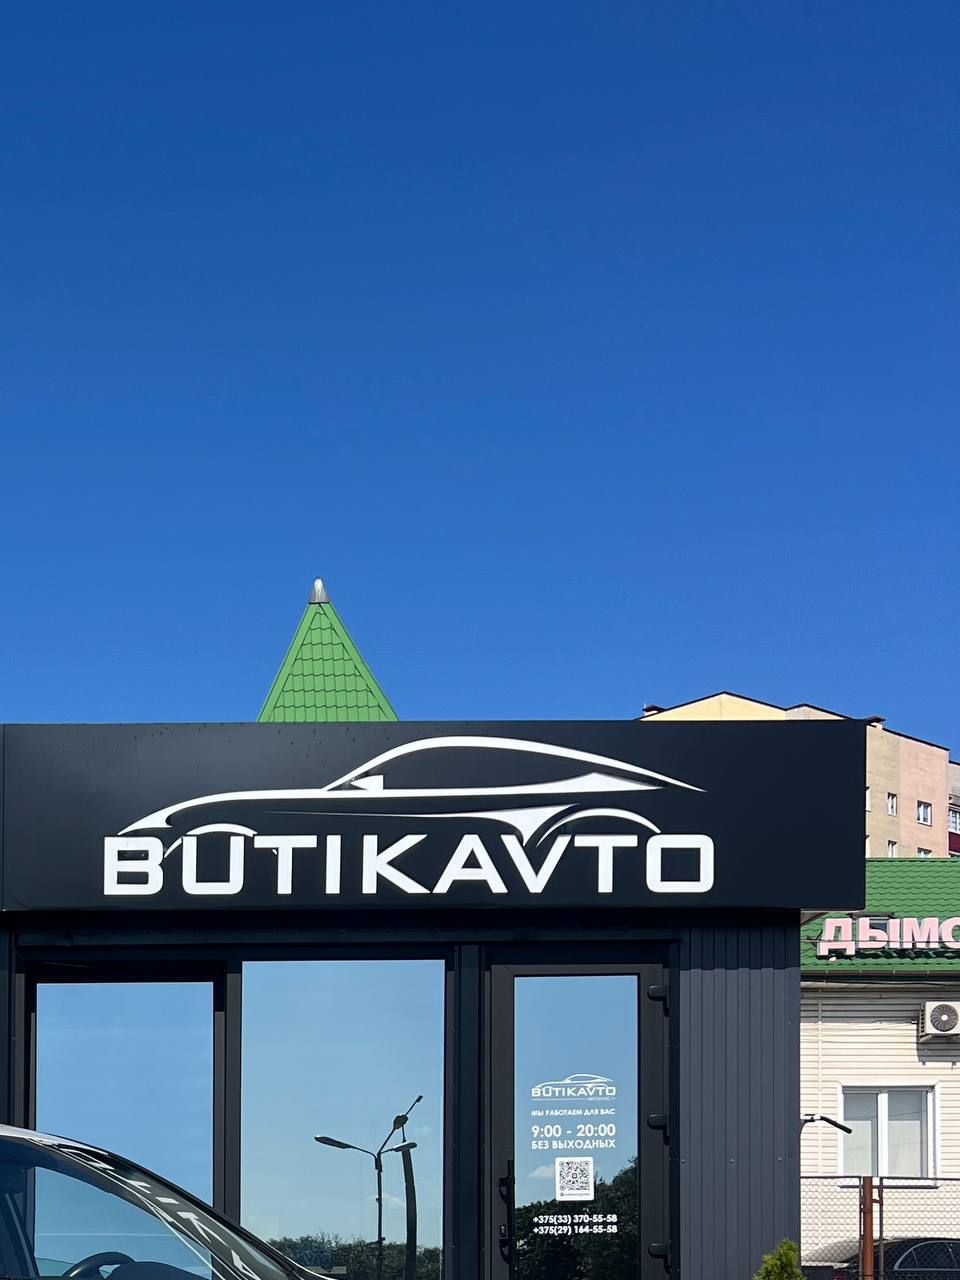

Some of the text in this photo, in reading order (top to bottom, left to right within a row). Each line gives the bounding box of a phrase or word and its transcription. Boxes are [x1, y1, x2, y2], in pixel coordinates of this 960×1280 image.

[103, 833, 715, 895] BUTIKAVTO
[531, 1086, 616, 1097] BUTIKAVTO
[531, 1125, 562, 1138] 9:00
[576, 1124, 616, 1137] 20:00
[531, 1139, 616, 1149] БЕЗ ВЫХОДНЫХ
[533, 1214, 618, 1224] +375(33) 370-55-58
[533, 1225, 618, 1235] +375(29) 164-55-58
